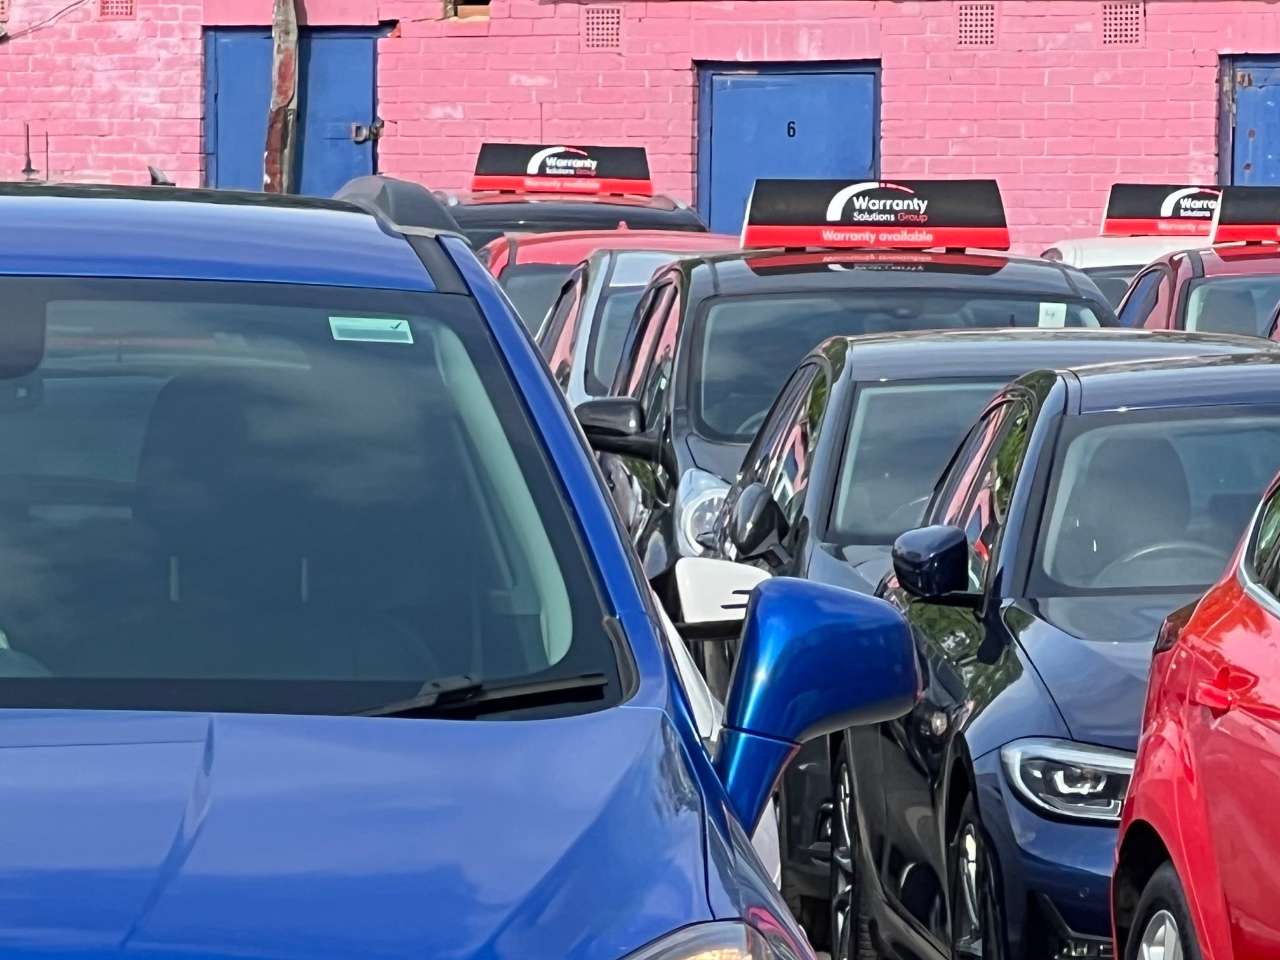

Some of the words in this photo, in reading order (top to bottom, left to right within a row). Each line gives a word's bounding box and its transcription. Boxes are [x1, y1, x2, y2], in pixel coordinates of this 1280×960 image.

[787, 120, 796, 138] 6
[545, 157, 598, 170] Warranty
[853, 196, 928, 215] Warranty
[1180, 197, 1217, 209] Warra
[853, 211, 895, 222] Solutions
[897, 213, 928, 224] Group
[822, 229, 877, 244] Warranty
[879, 230, 933, 243] available
